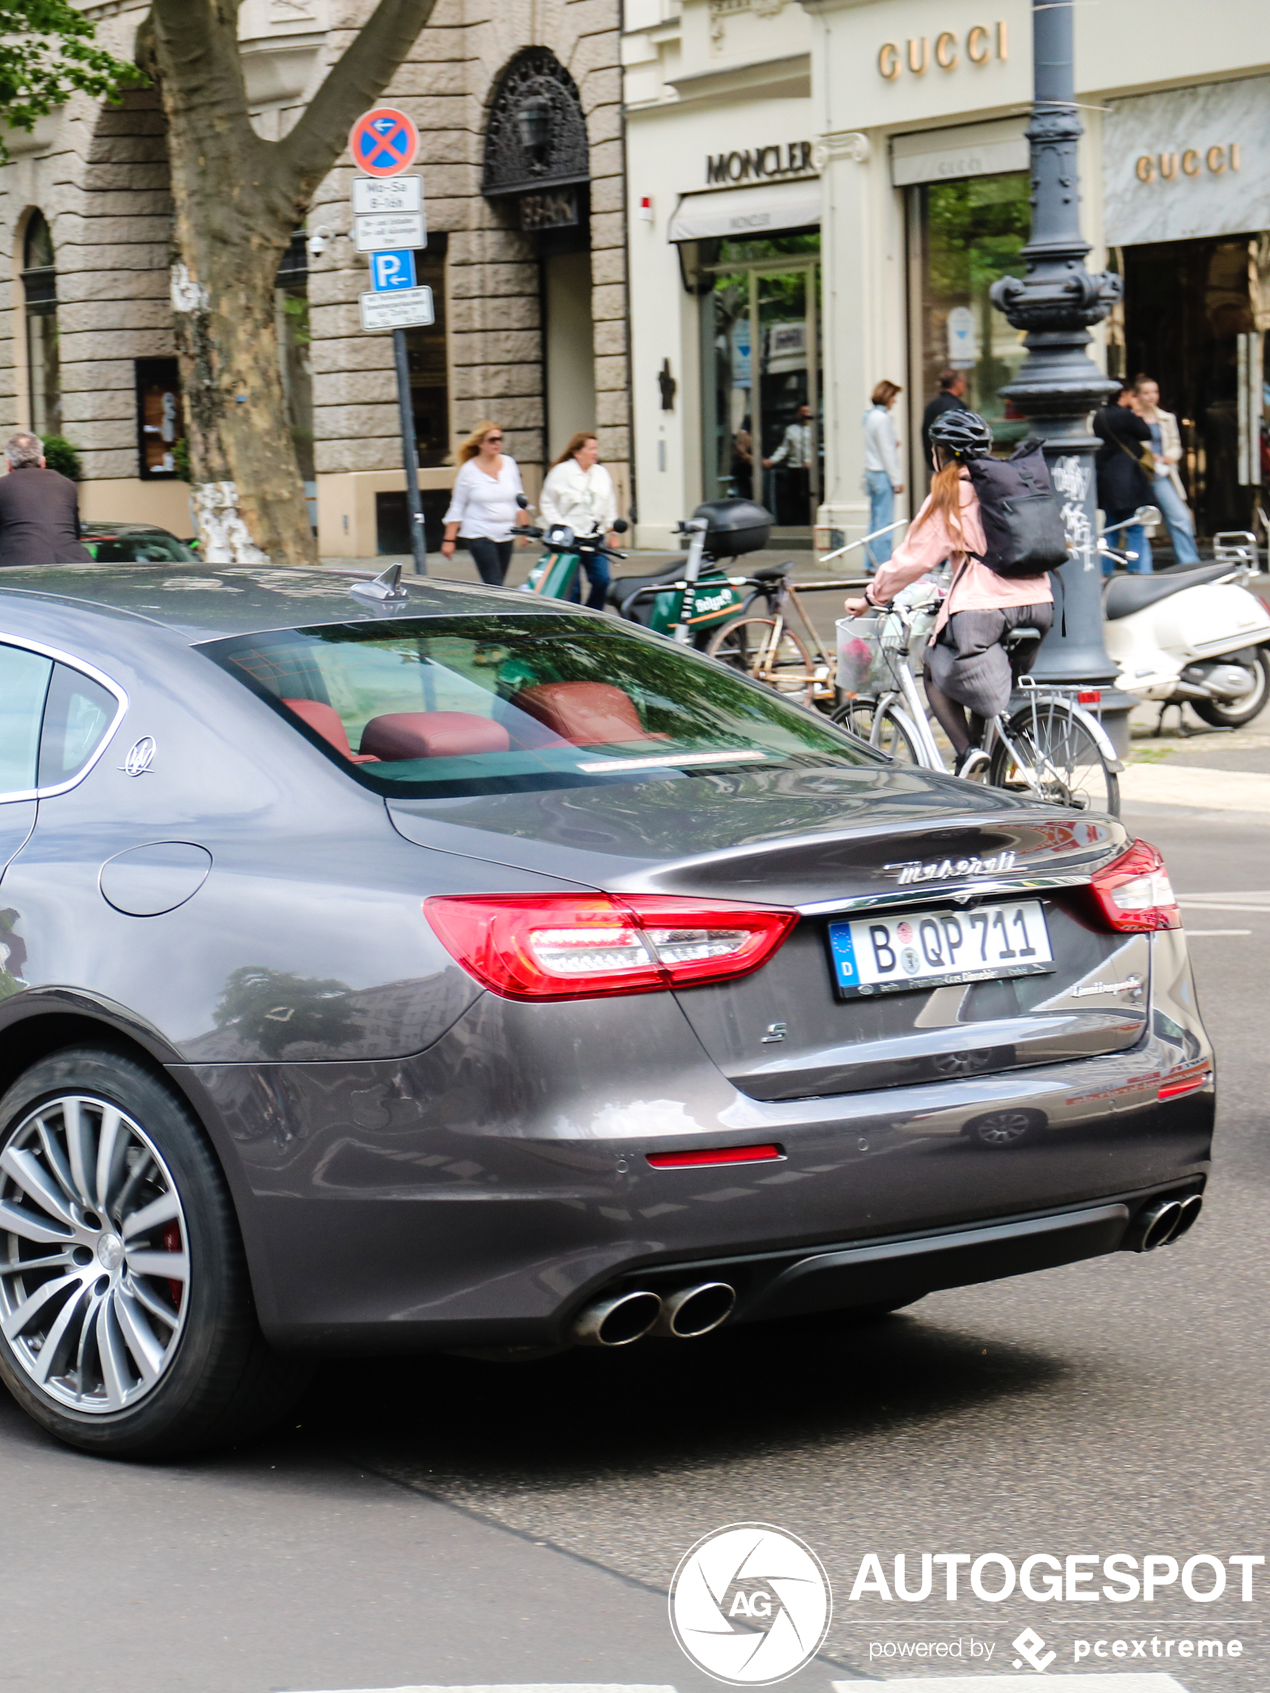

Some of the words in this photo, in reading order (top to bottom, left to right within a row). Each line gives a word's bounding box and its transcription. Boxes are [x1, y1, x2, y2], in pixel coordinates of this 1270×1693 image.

[878, 20, 1008, 82] GUCCI
[706, 140, 815, 184] MONCLER
[1135, 143, 1241, 184] GUCCI
[376, 254, 402, 287] P
[883, 850, 1029, 886] Maserati
[868, 924, 897, 974] B
[918, 915, 964, 967] QP
[968, 908, 1037, 962] 711
[841, 961, 853, 976] D
